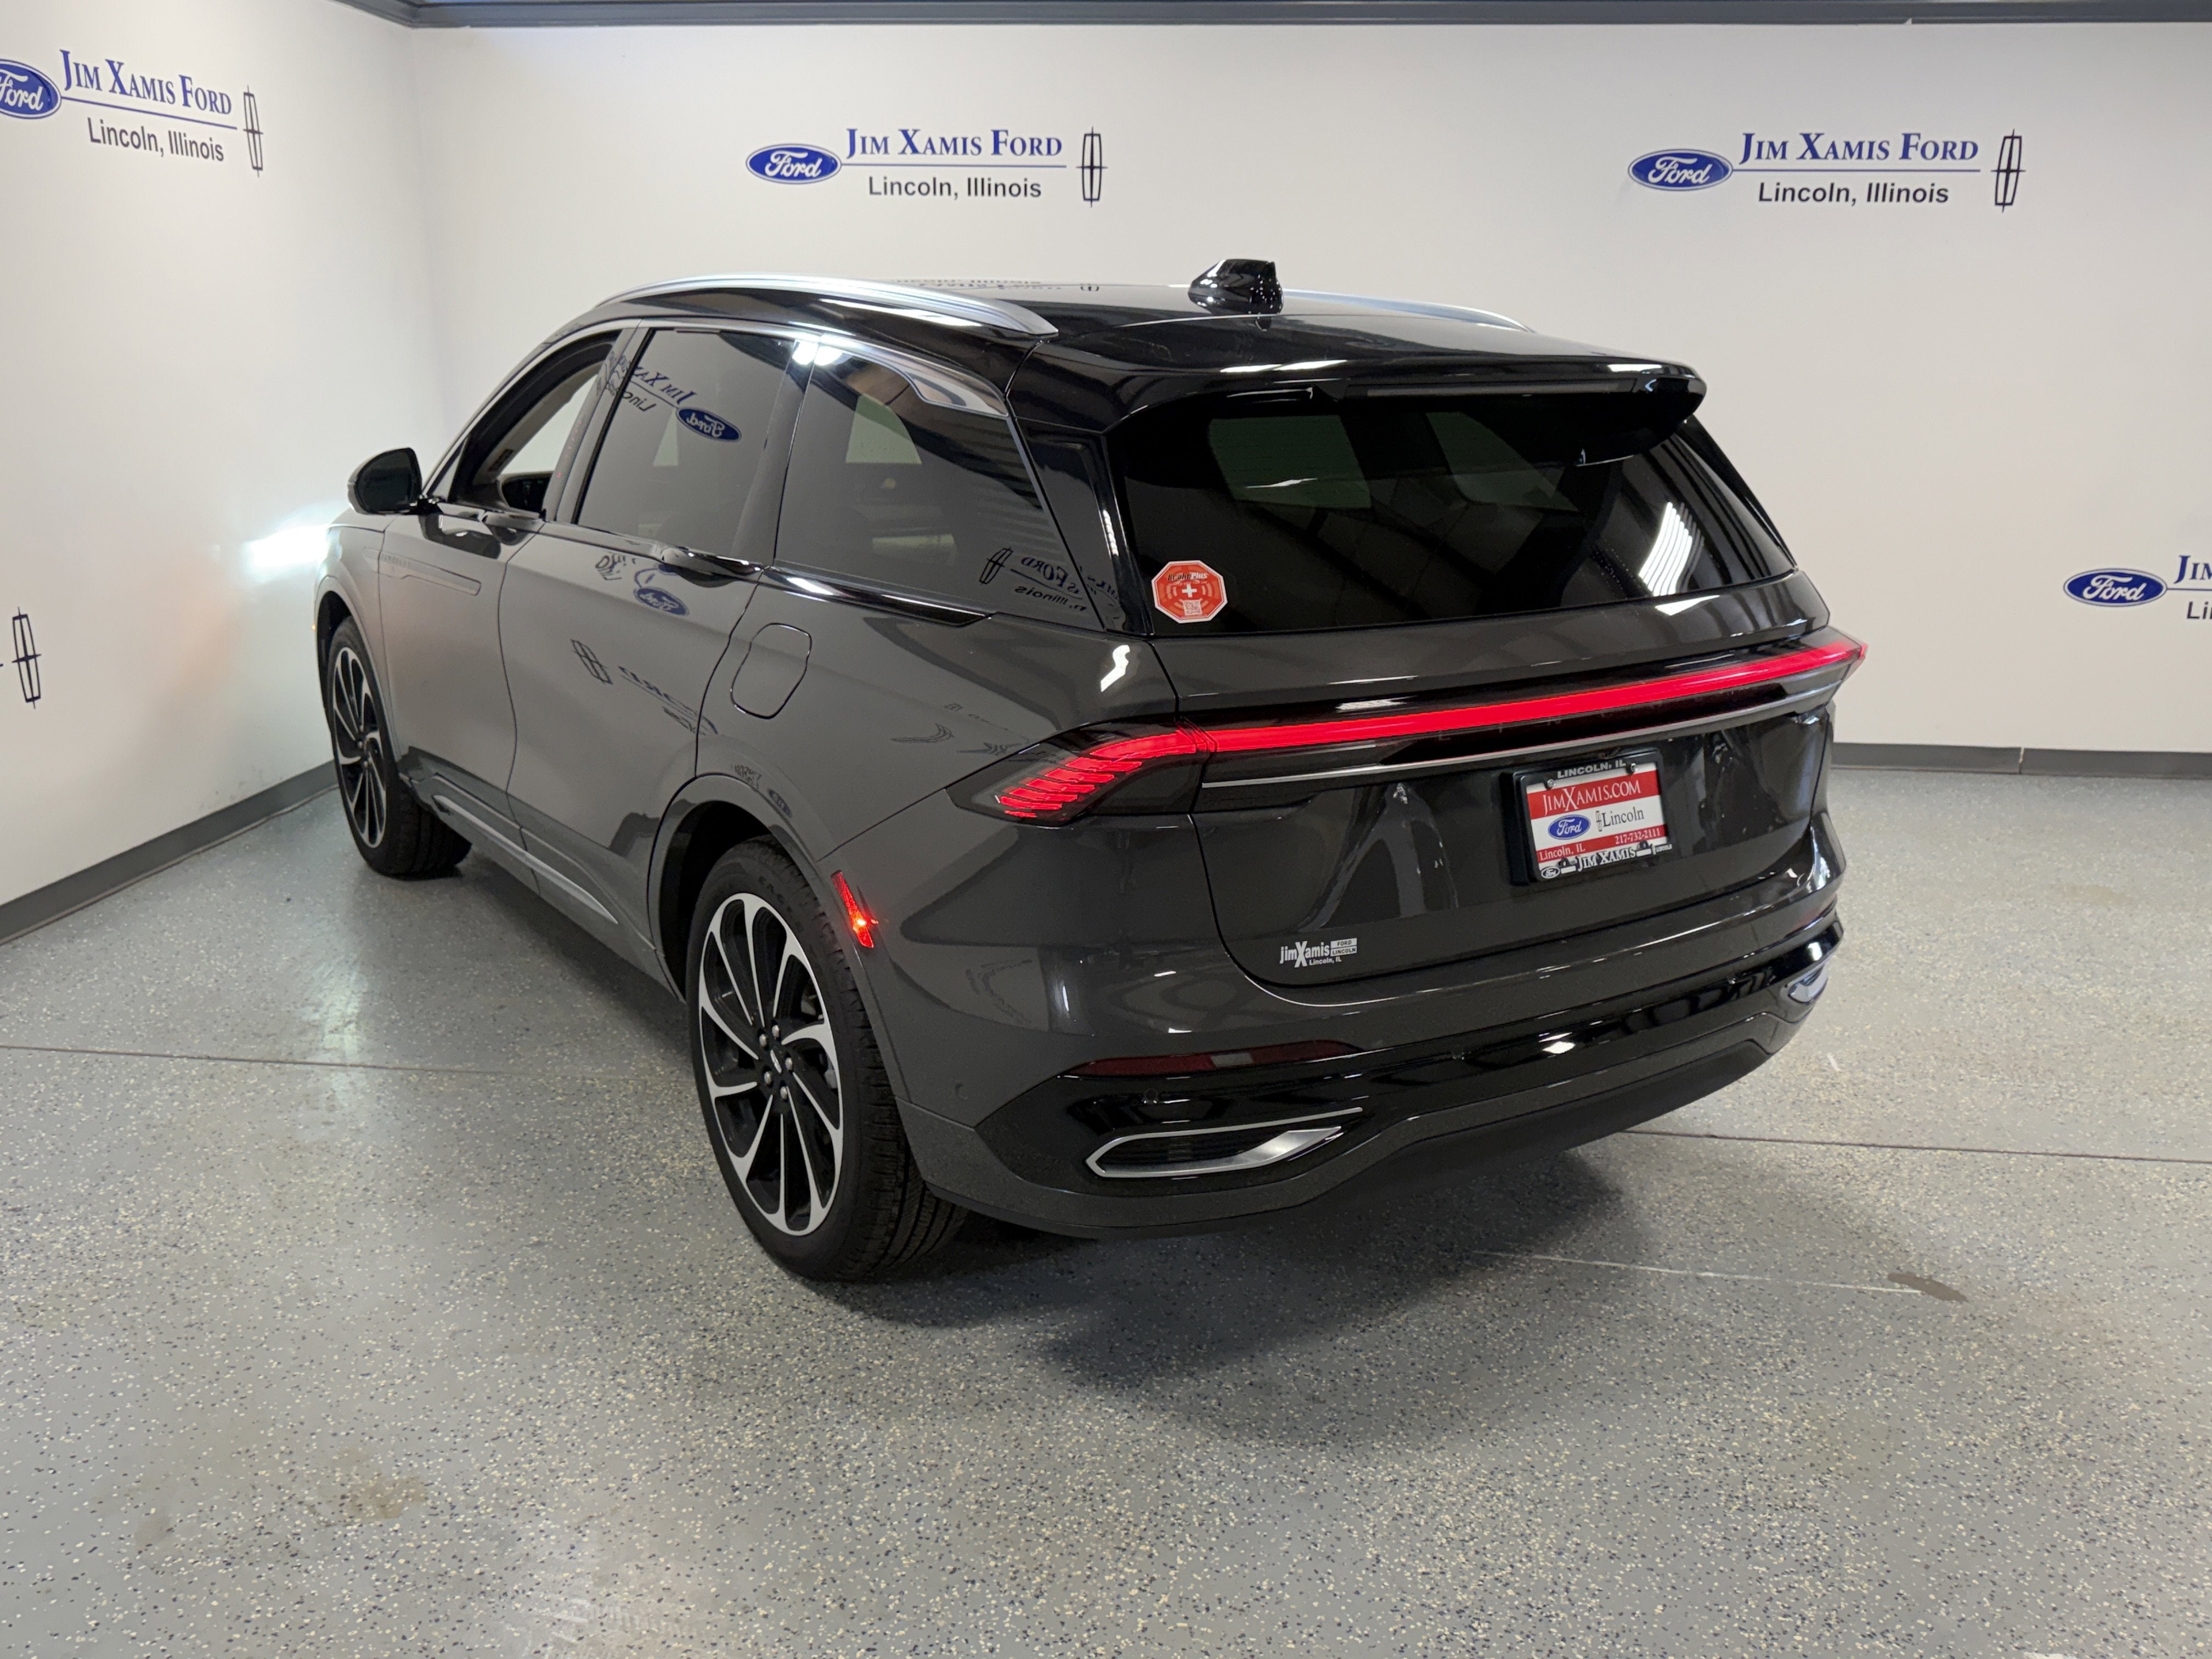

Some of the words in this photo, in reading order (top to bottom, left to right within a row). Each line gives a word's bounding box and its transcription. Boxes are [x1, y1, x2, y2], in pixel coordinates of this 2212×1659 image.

[105, 58, 176, 105] XAMIS
[179, 74, 232, 115] FORD
[87, 116, 164, 157] Lincoln,
[168, 129, 224, 162] Illinois
[846, 128, 890, 160] JIM
[898, 129, 982, 156] XAMIS
[991, 129, 1062, 156] FORD
[1738, 133, 1788, 165] JIM
[1795, 133, 1891, 161] XAMIS
[1898, 133, 1979, 161] FORD
[764, 150, 822, 179] Ford
[1647, 156, 1711, 185] Ford
[868, 176, 959, 200] Lincoln,
[967, 177, 1042, 198] Illinois
[1758, 182, 1857, 206] Lincoln,
[1866, 182, 1949, 204] Illinois
[2083, 574, 2147, 600] Ford
[1615, 759, 1626, 769] IL
[1556, 818, 1582, 836] Ford
[1601, 806, 1644, 828] Lincoln
[1576, 843, 1586, 853] IL
[1615, 827, 1661, 845] 217-732-2111
[1600, 847, 1636, 864] XAMIS
[1309, 957, 1334, 966] Lincoln,
[1332, 947, 1356, 955] LINCOLN
